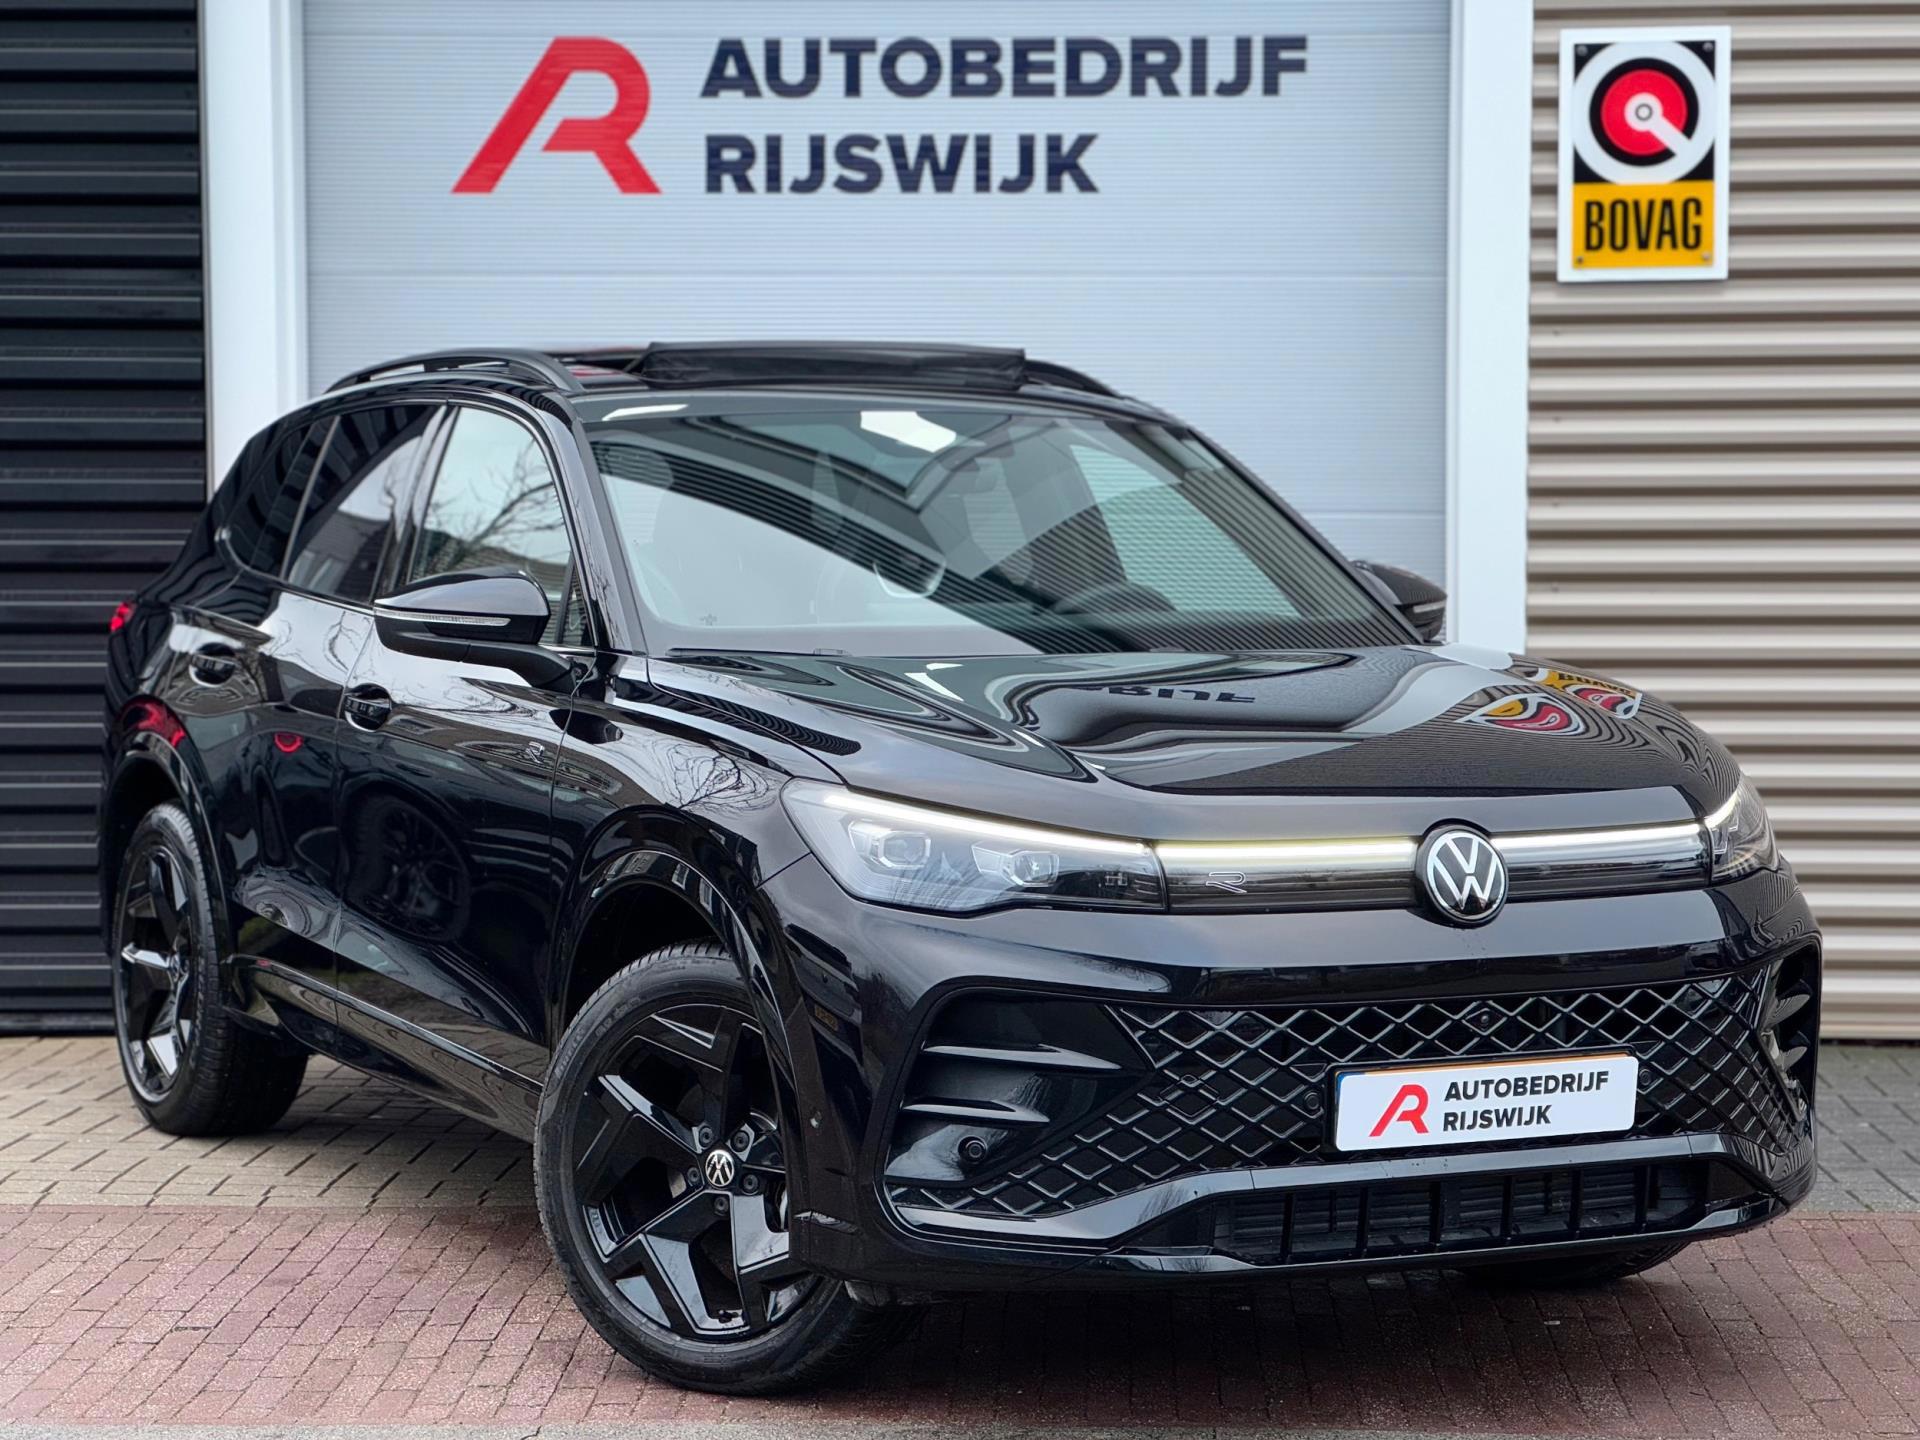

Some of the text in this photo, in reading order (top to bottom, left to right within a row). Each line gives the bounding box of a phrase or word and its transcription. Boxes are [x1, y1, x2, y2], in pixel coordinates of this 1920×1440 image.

[701, 36, 1308, 98] AUTOBEDRIJF
[705, 134, 1098, 194] RIJSWIJK
[1585, 197, 1703, 252] BOVAG
[1444, 1071, 1609, 1102] AUTOBEDRIJF
[1443, 1105, 1552, 1132] RIJSWIJK
